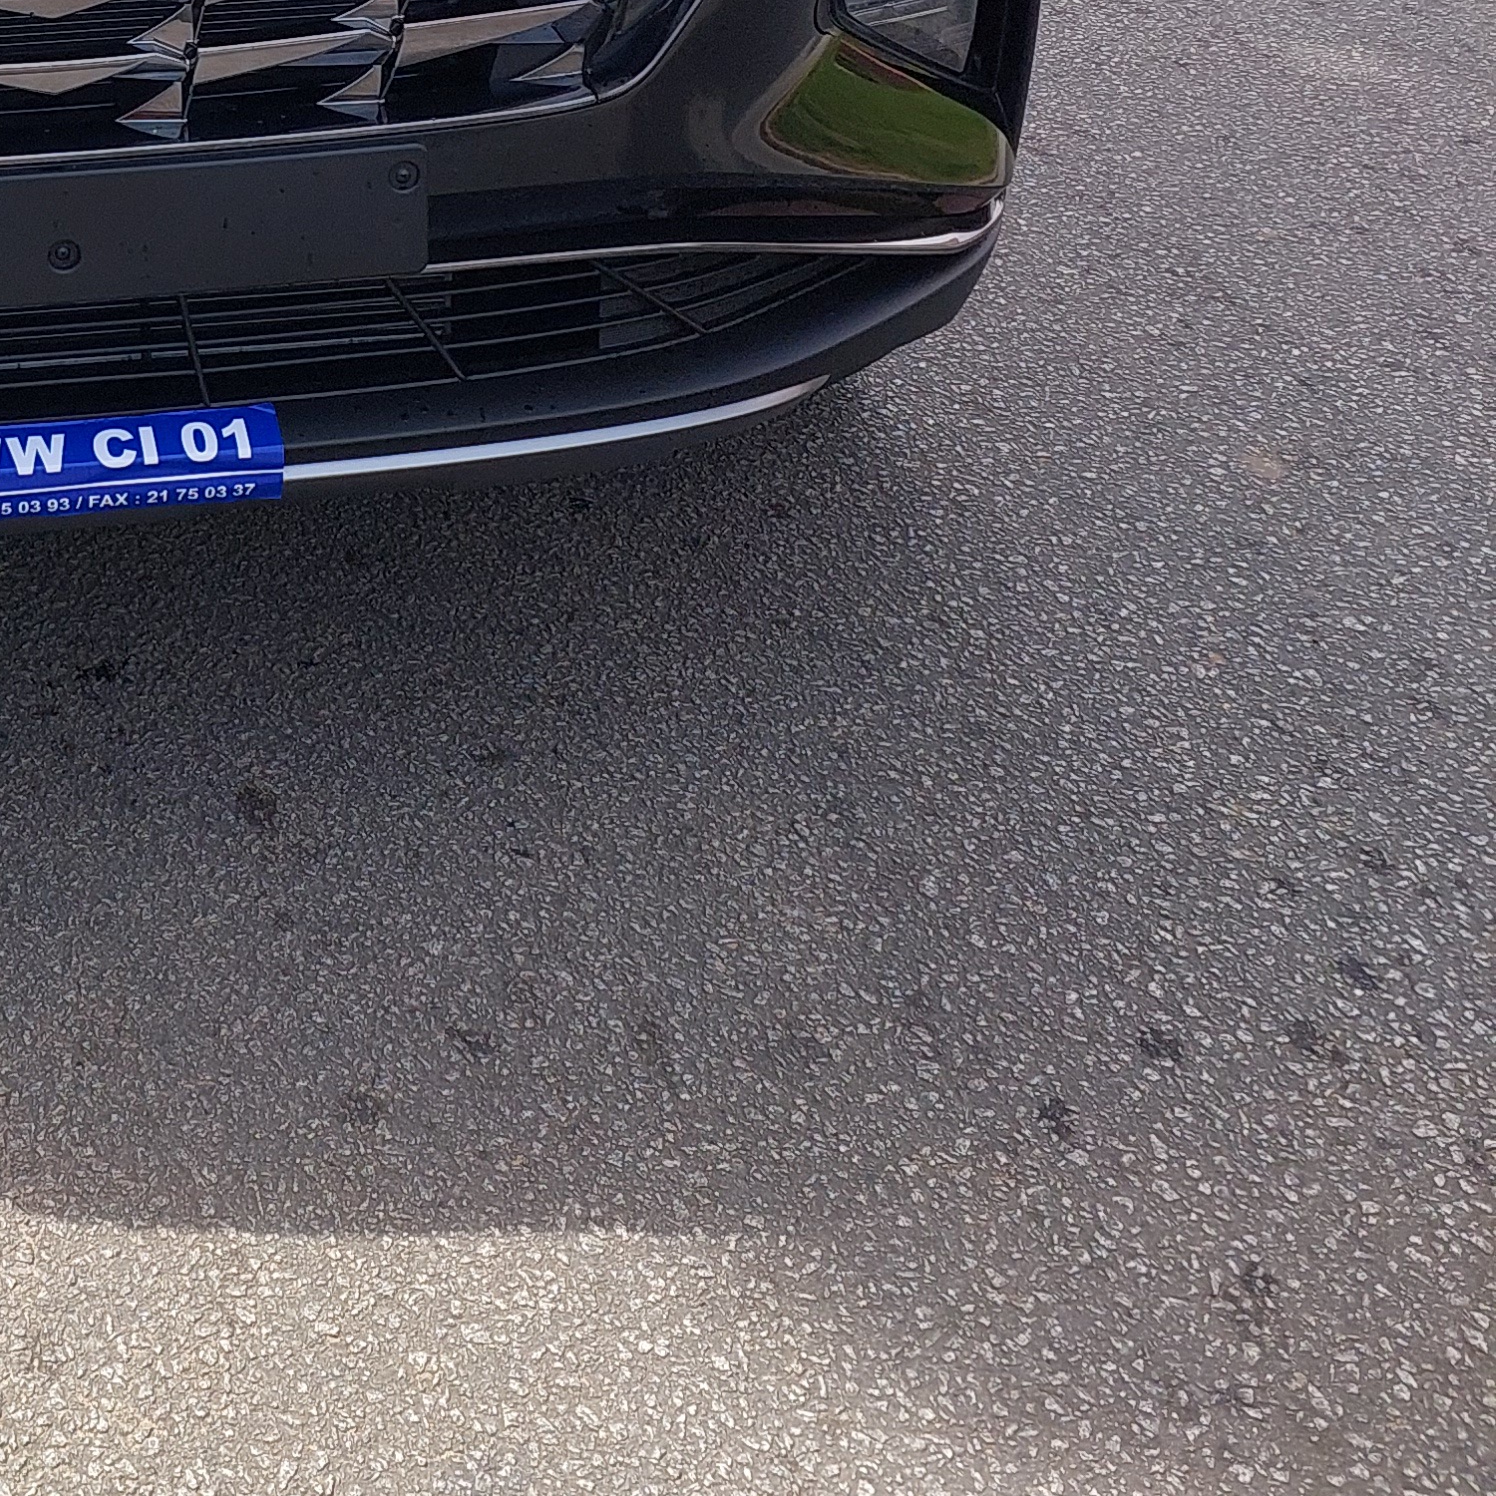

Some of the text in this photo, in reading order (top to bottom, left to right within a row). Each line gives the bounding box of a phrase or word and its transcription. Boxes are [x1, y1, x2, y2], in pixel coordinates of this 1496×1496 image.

[92, 425, 160, 470] CI
[180, 418, 253, 464] 01
[18, 500, 41, 514] 03
[47, 497, 71, 512] 93
[75, 495, 83, 509] /
[88, 492, 128, 508] FAX
[147, 490, 168, 504] 21
[176, 487, 199, 501] 75
[204, 485, 227, 499] 03
[232, 483, 256, 497] 37
